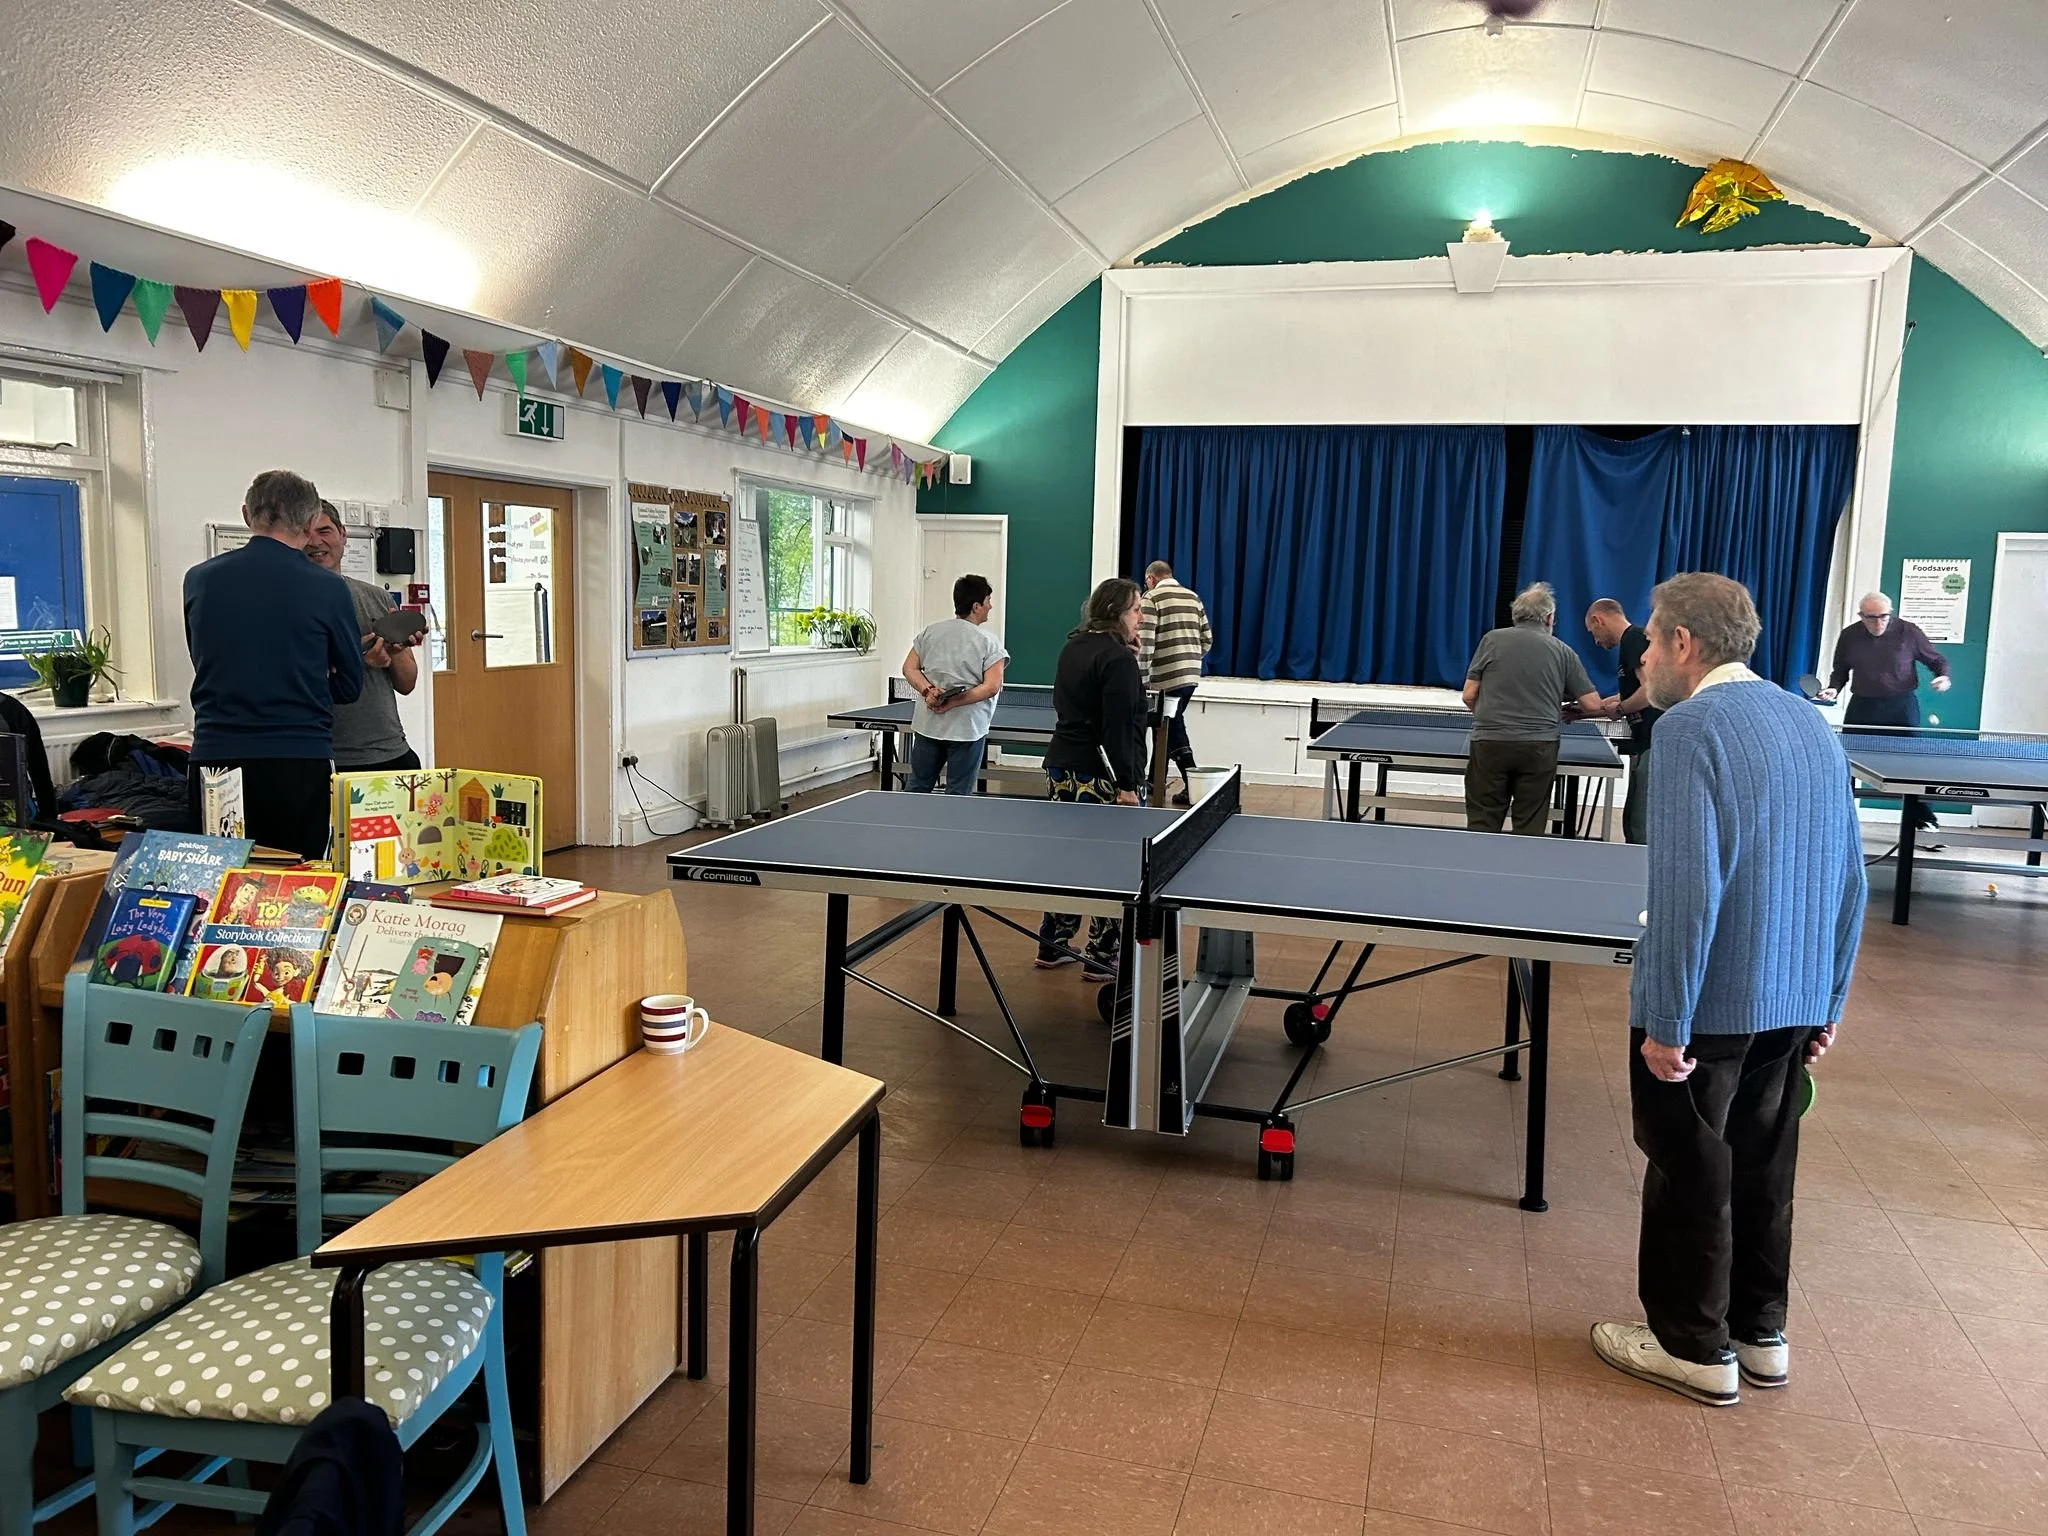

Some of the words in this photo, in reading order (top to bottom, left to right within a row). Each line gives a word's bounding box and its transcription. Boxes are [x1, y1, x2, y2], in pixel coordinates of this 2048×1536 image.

[1912, 564, 1959, 572] Foodsavers
[1946, 788, 1984, 797] cornilleau
[177, 841, 208, 854] pinkfong
[157, 849, 187, 863] BABY
[184, 852, 224, 866] SHARK
[702, 871, 753, 883] cornilleau
[128, 907, 145, 921] The
[148, 908, 167, 923] Very
[257, 901, 290, 919] TOY
[110, 921, 134, 936] Lazy
[137, 919, 175, 941] Ladybird
[371, 908, 411, 926] Katie
[414, 913, 467, 937] Morag
[215, 927, 265, 943] Storybook
[265, 930, 312, 944] Collection
[376, 925, 412, 938] Delivers
